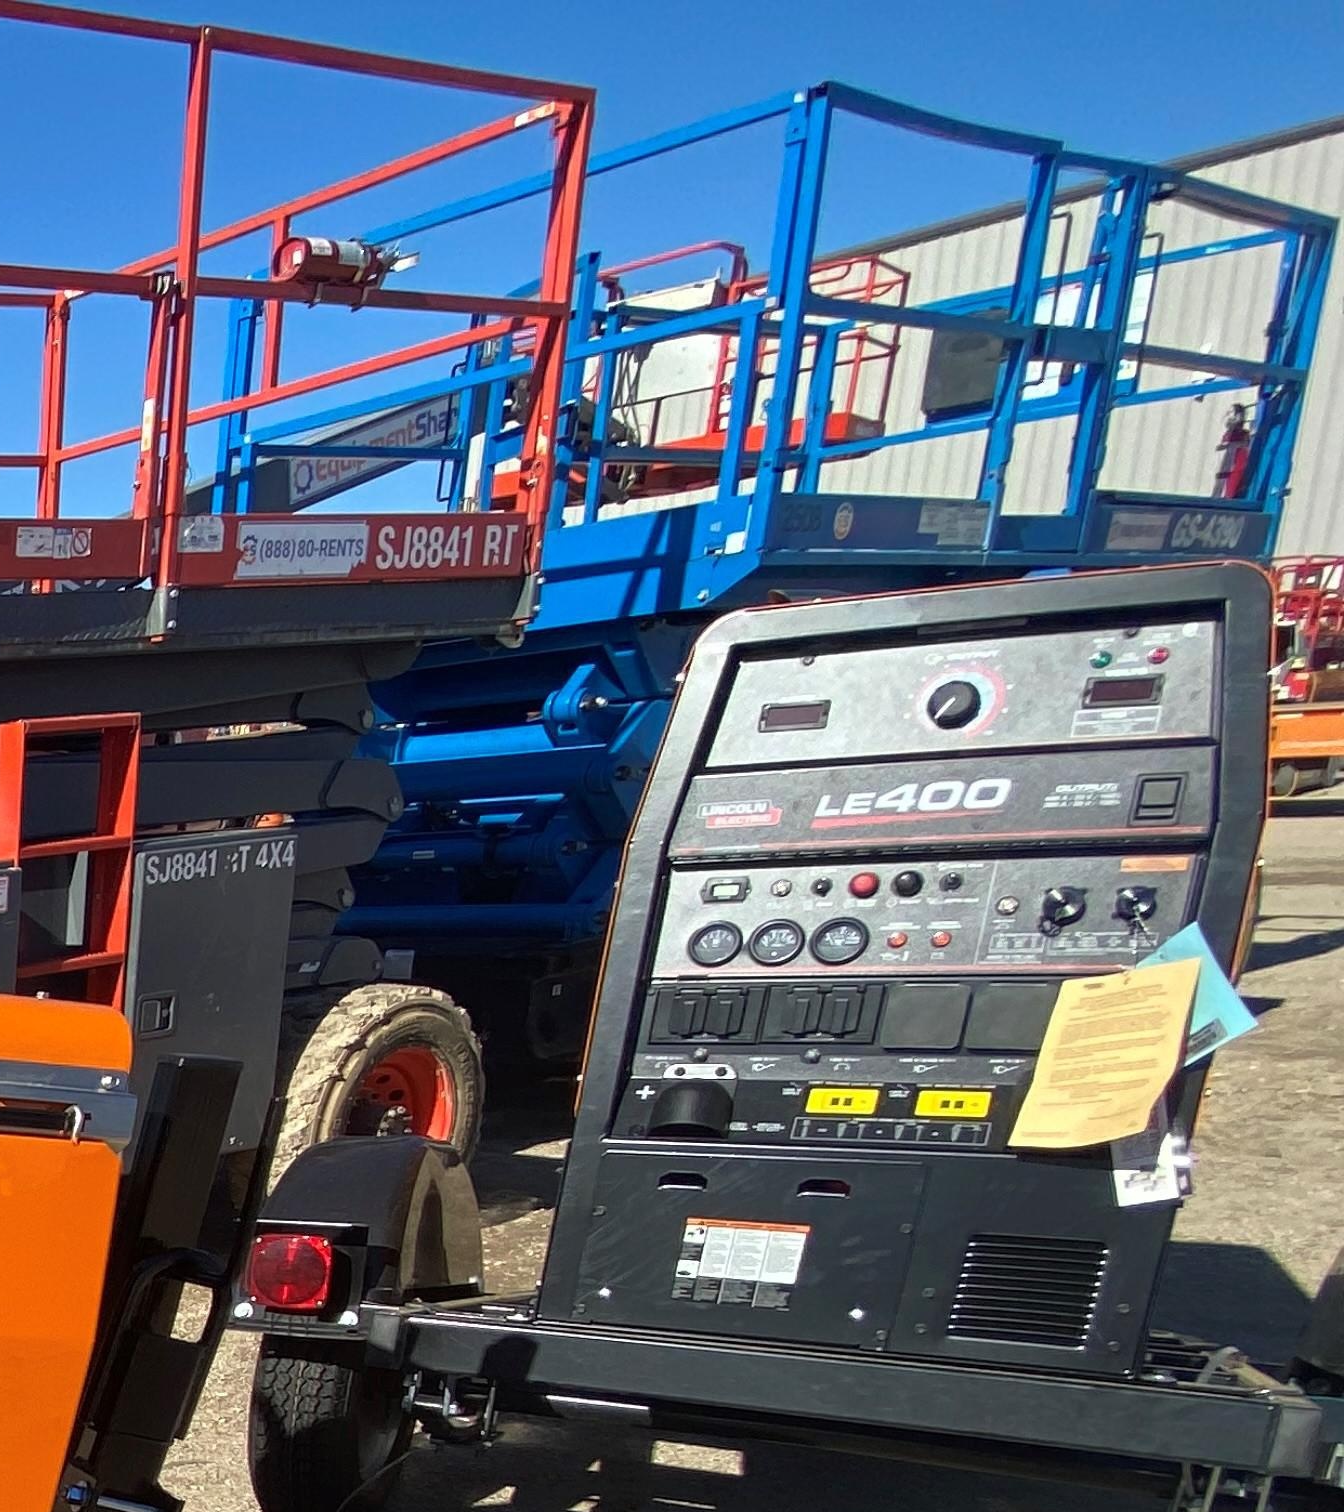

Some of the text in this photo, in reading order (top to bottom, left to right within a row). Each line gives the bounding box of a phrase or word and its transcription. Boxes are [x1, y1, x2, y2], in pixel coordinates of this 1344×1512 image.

[376, 525, 474, 571] SJ8841
[700, 802, 768, 817] LINCOLN
[814, 778, 1012, 817] LE400
[145, 849, 218, 885] SJ8841
[255, 840, 295, 869] 4X4
